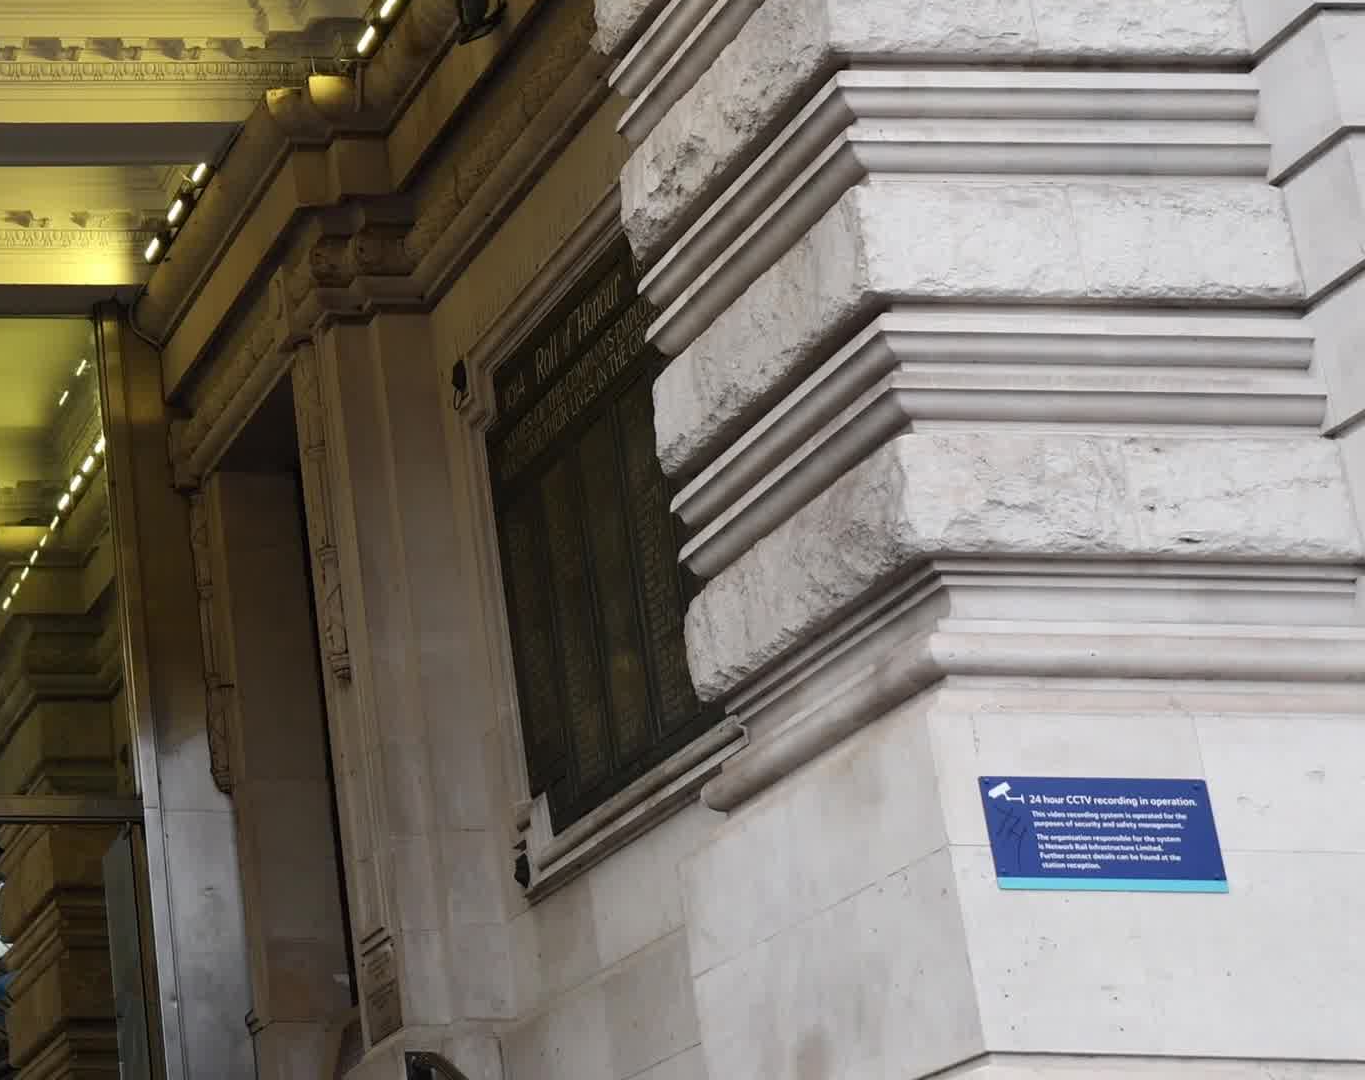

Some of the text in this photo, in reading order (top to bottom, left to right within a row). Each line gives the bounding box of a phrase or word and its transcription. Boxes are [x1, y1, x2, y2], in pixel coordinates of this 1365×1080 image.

[1029, 795, 1042, 803] 24
[1043, 795, 1064, 803] hour
[1066, 796, 1091, 804] CCTV
[1094, 797, 1137, 806] recording
[1150, 798, 1197, 806] operation.
[1067, 811, 1098, 820] recording
[1100, 812, 1124, 820] system
[1093, 835, 1132, 843] responsible
[1157, 837, 1181, 845] system
